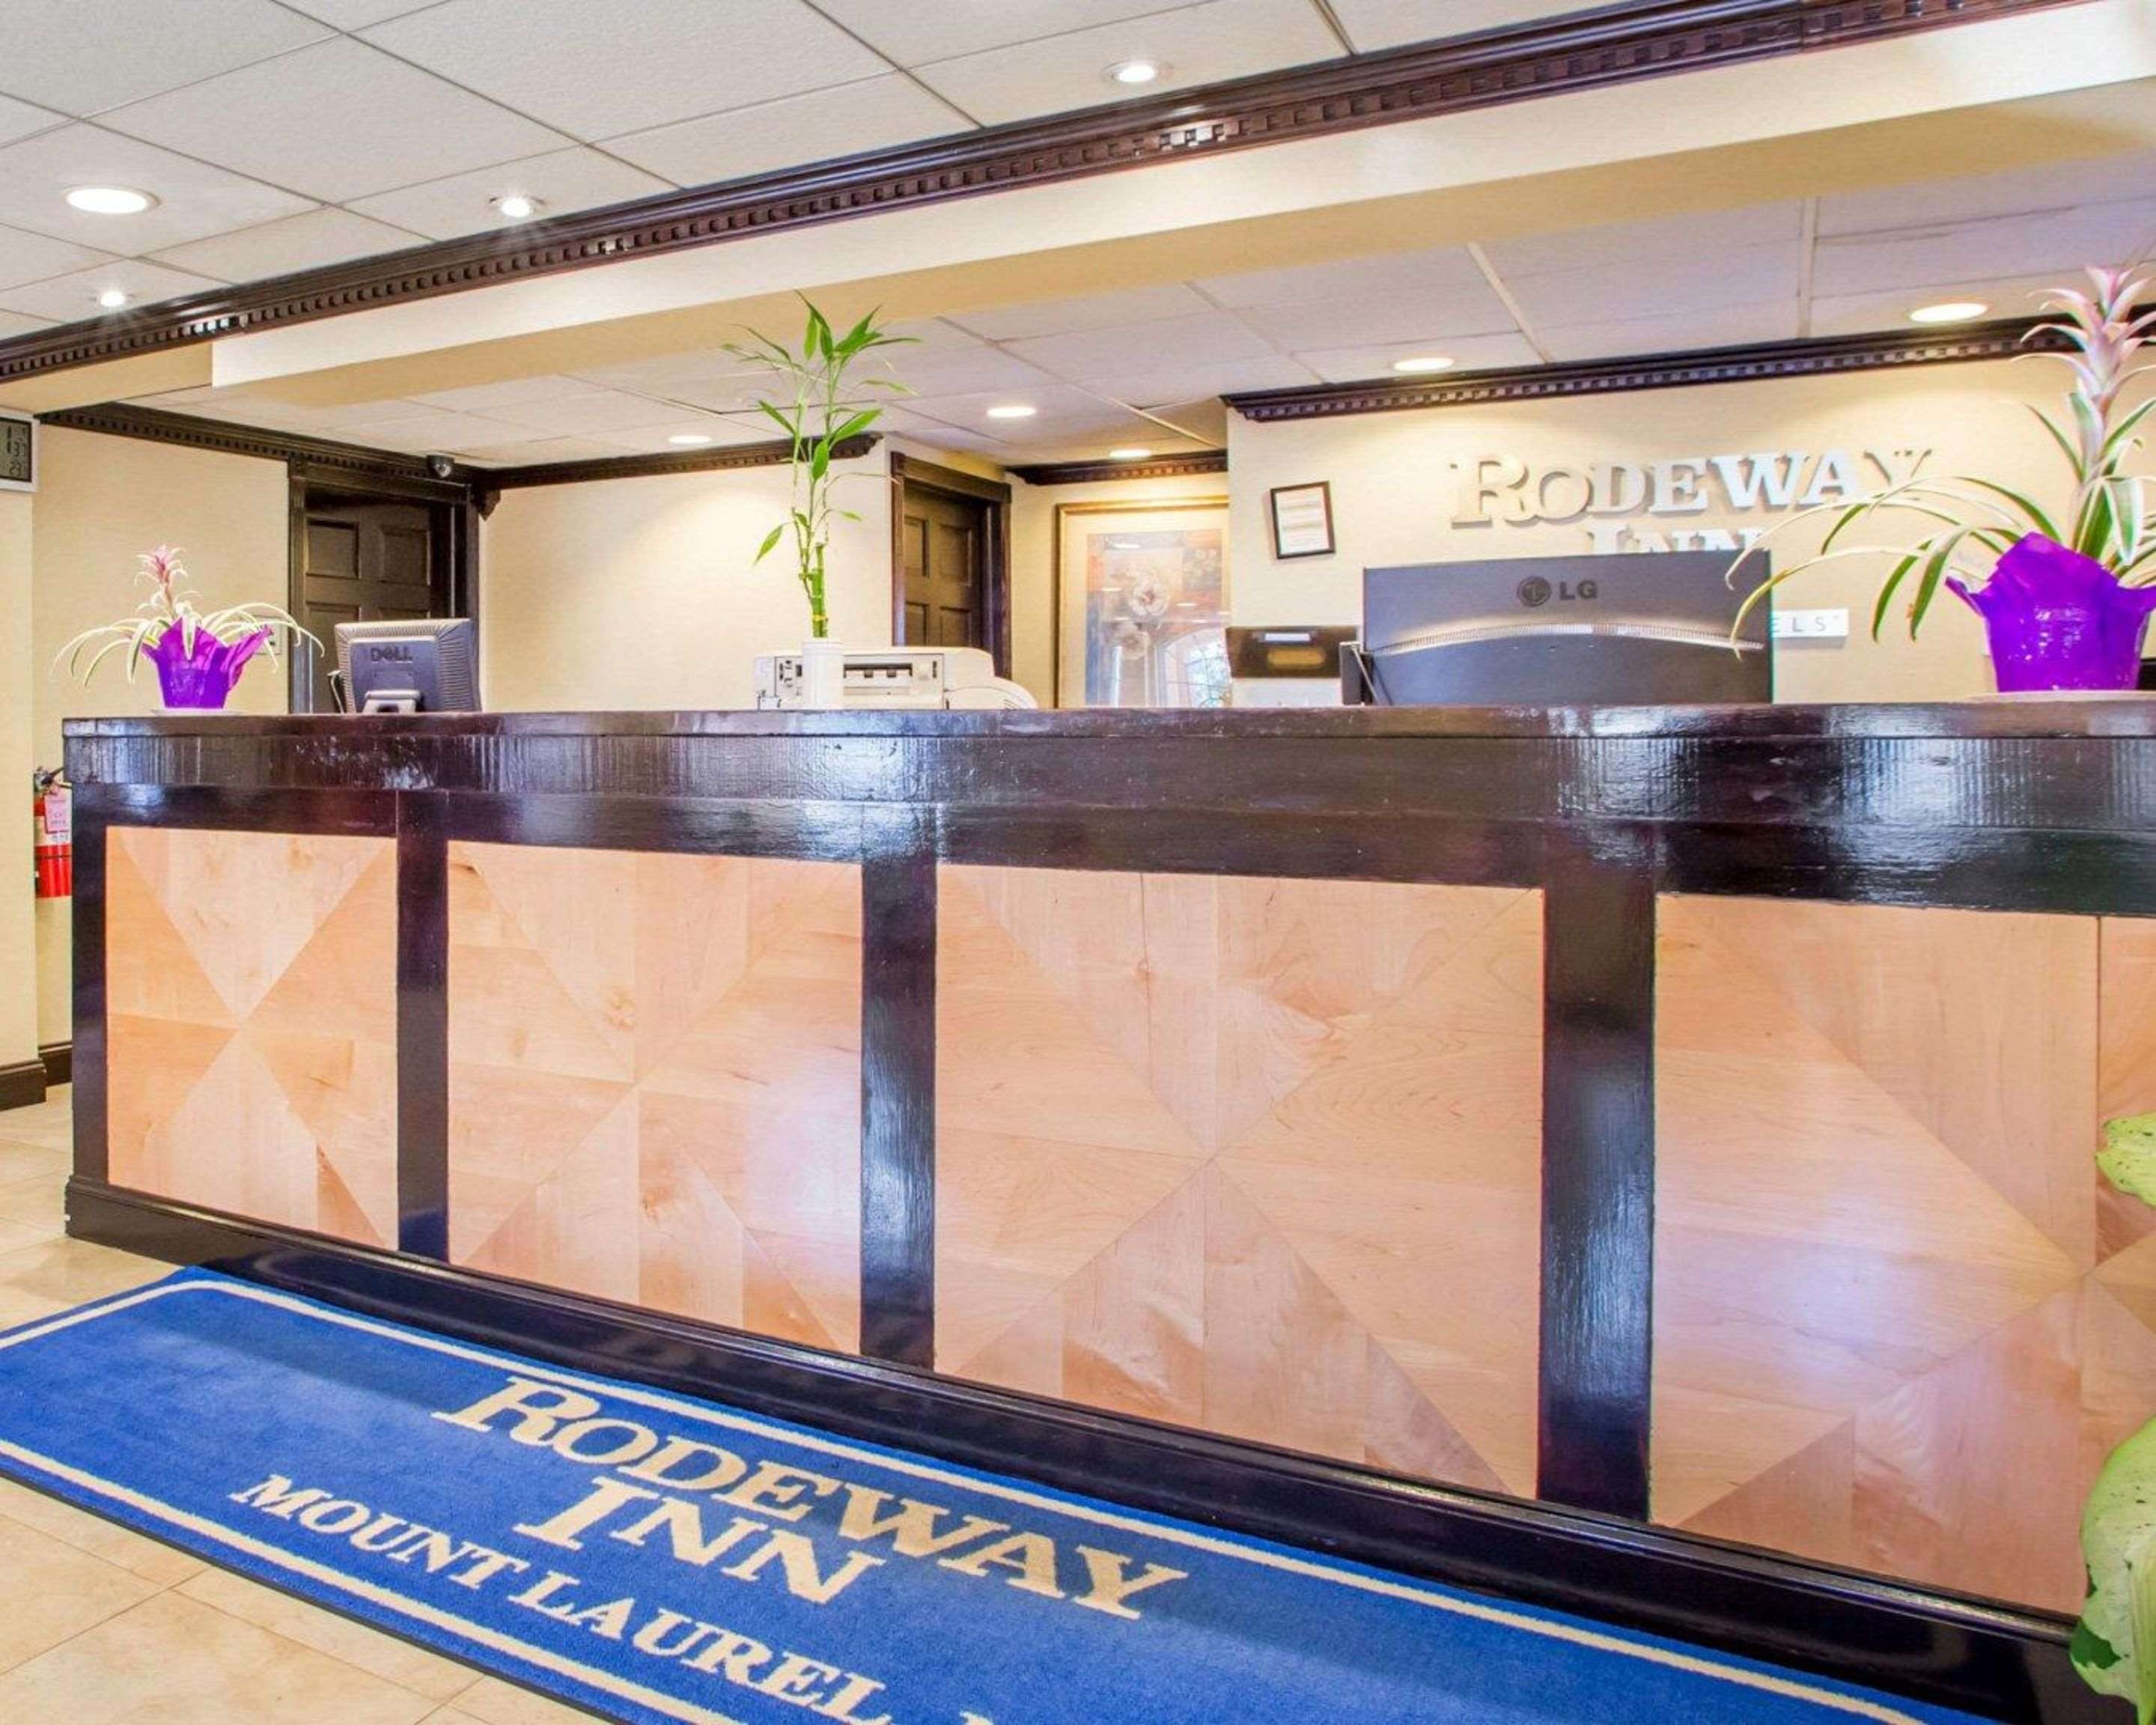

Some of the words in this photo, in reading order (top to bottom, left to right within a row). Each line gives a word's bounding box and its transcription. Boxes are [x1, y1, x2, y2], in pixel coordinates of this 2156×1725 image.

[1449, 447, 1933, 529] RODEWAY
[1559, 579, 1598, 600] LG
[371, 647, 414, 662] DELL
[431, 1375, 1189, 1620] RODEWAY
[513, 1476, 886, 1604] INN
[227, 1473, 529, 1589] MOUNT
[508, 1570, 892, 1725] LAUREL
